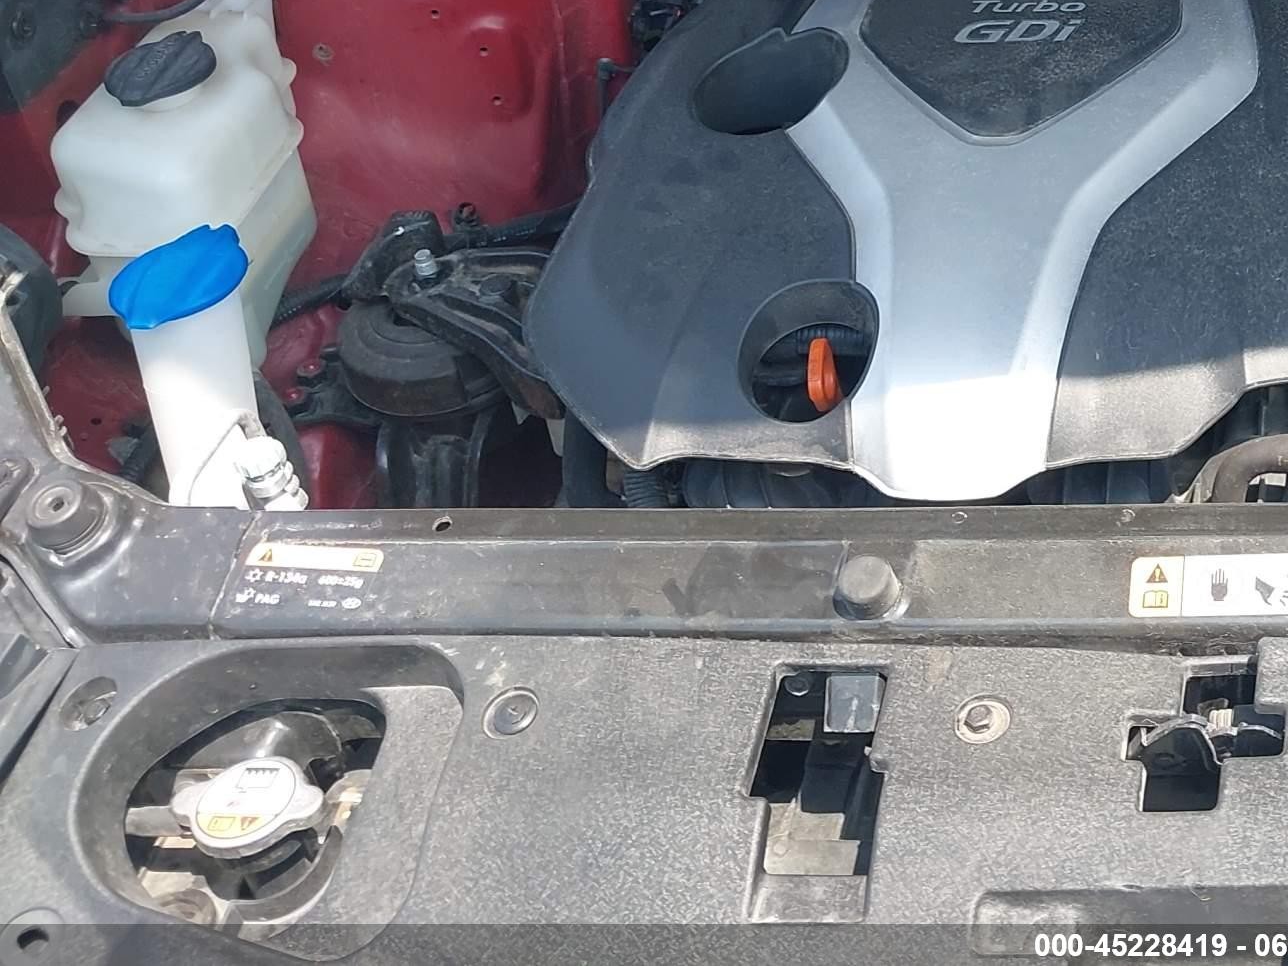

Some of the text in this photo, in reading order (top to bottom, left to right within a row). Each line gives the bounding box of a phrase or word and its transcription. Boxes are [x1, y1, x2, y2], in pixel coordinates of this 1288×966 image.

[972, 0, 1087, 13] Turbo
[953, 18, 1086, 43] GDi
[254, 593, 281, 605] PAG
